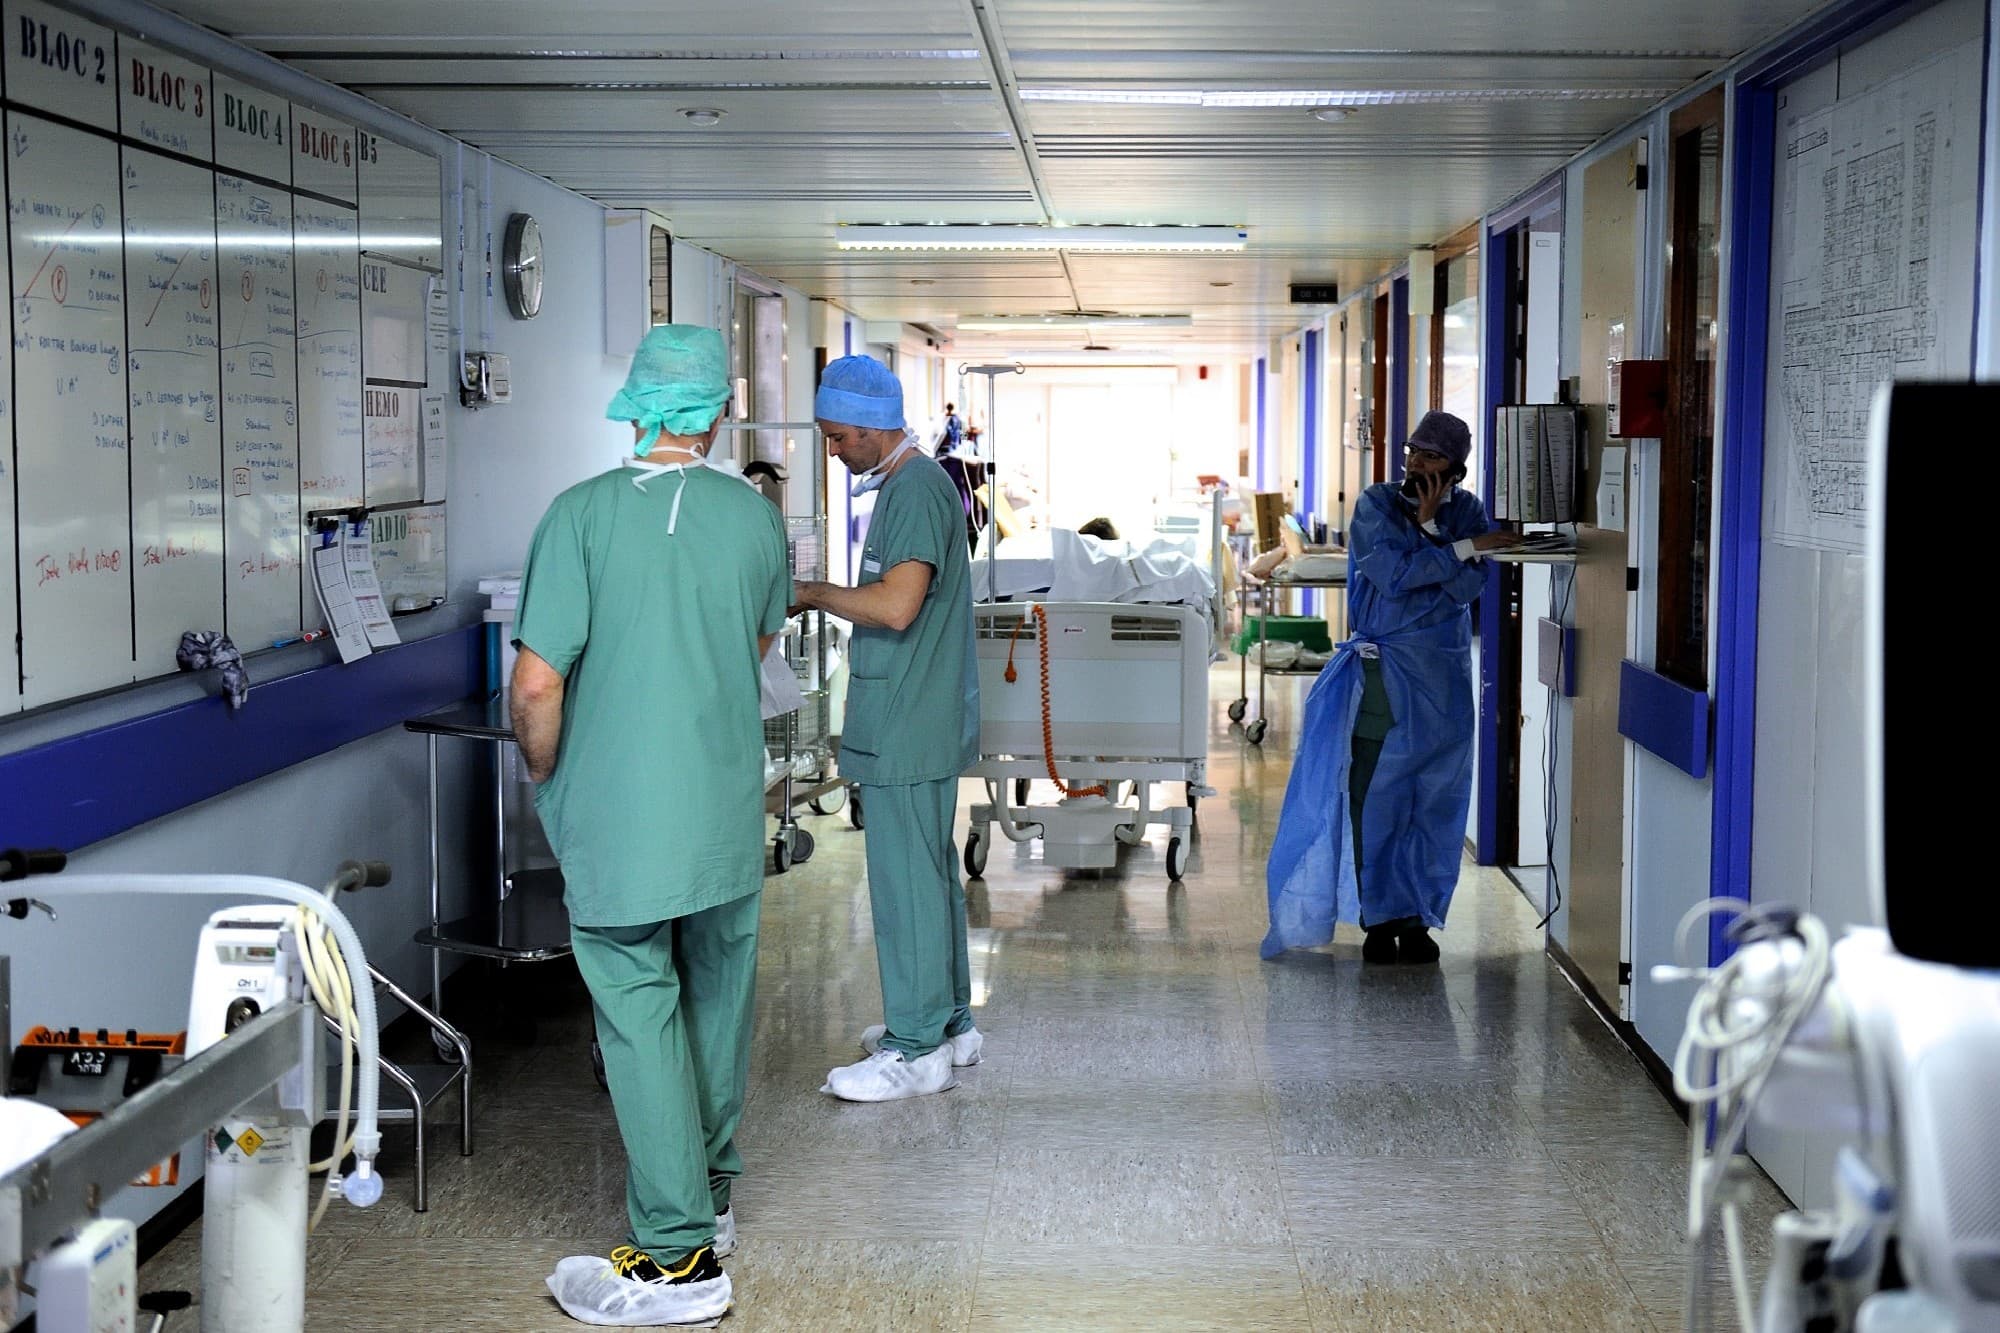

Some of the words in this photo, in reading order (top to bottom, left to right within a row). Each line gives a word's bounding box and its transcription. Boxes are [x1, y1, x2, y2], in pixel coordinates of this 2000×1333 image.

[20, 14, 87, 78] BLOC
[94, 45, 106, 85] 2
[132, 57, 186, 113] BLOC
[194, 83, 204, 118] 3
[224, 93, 269, 140] BLOC
[274, 113, 283, 146] 4
[300, 122, 339, 163] BLOC
[343, 139, 351, 168] 6
[363, 264, 387, 293] CEE
[366, 390, 399, 418] HEMO
